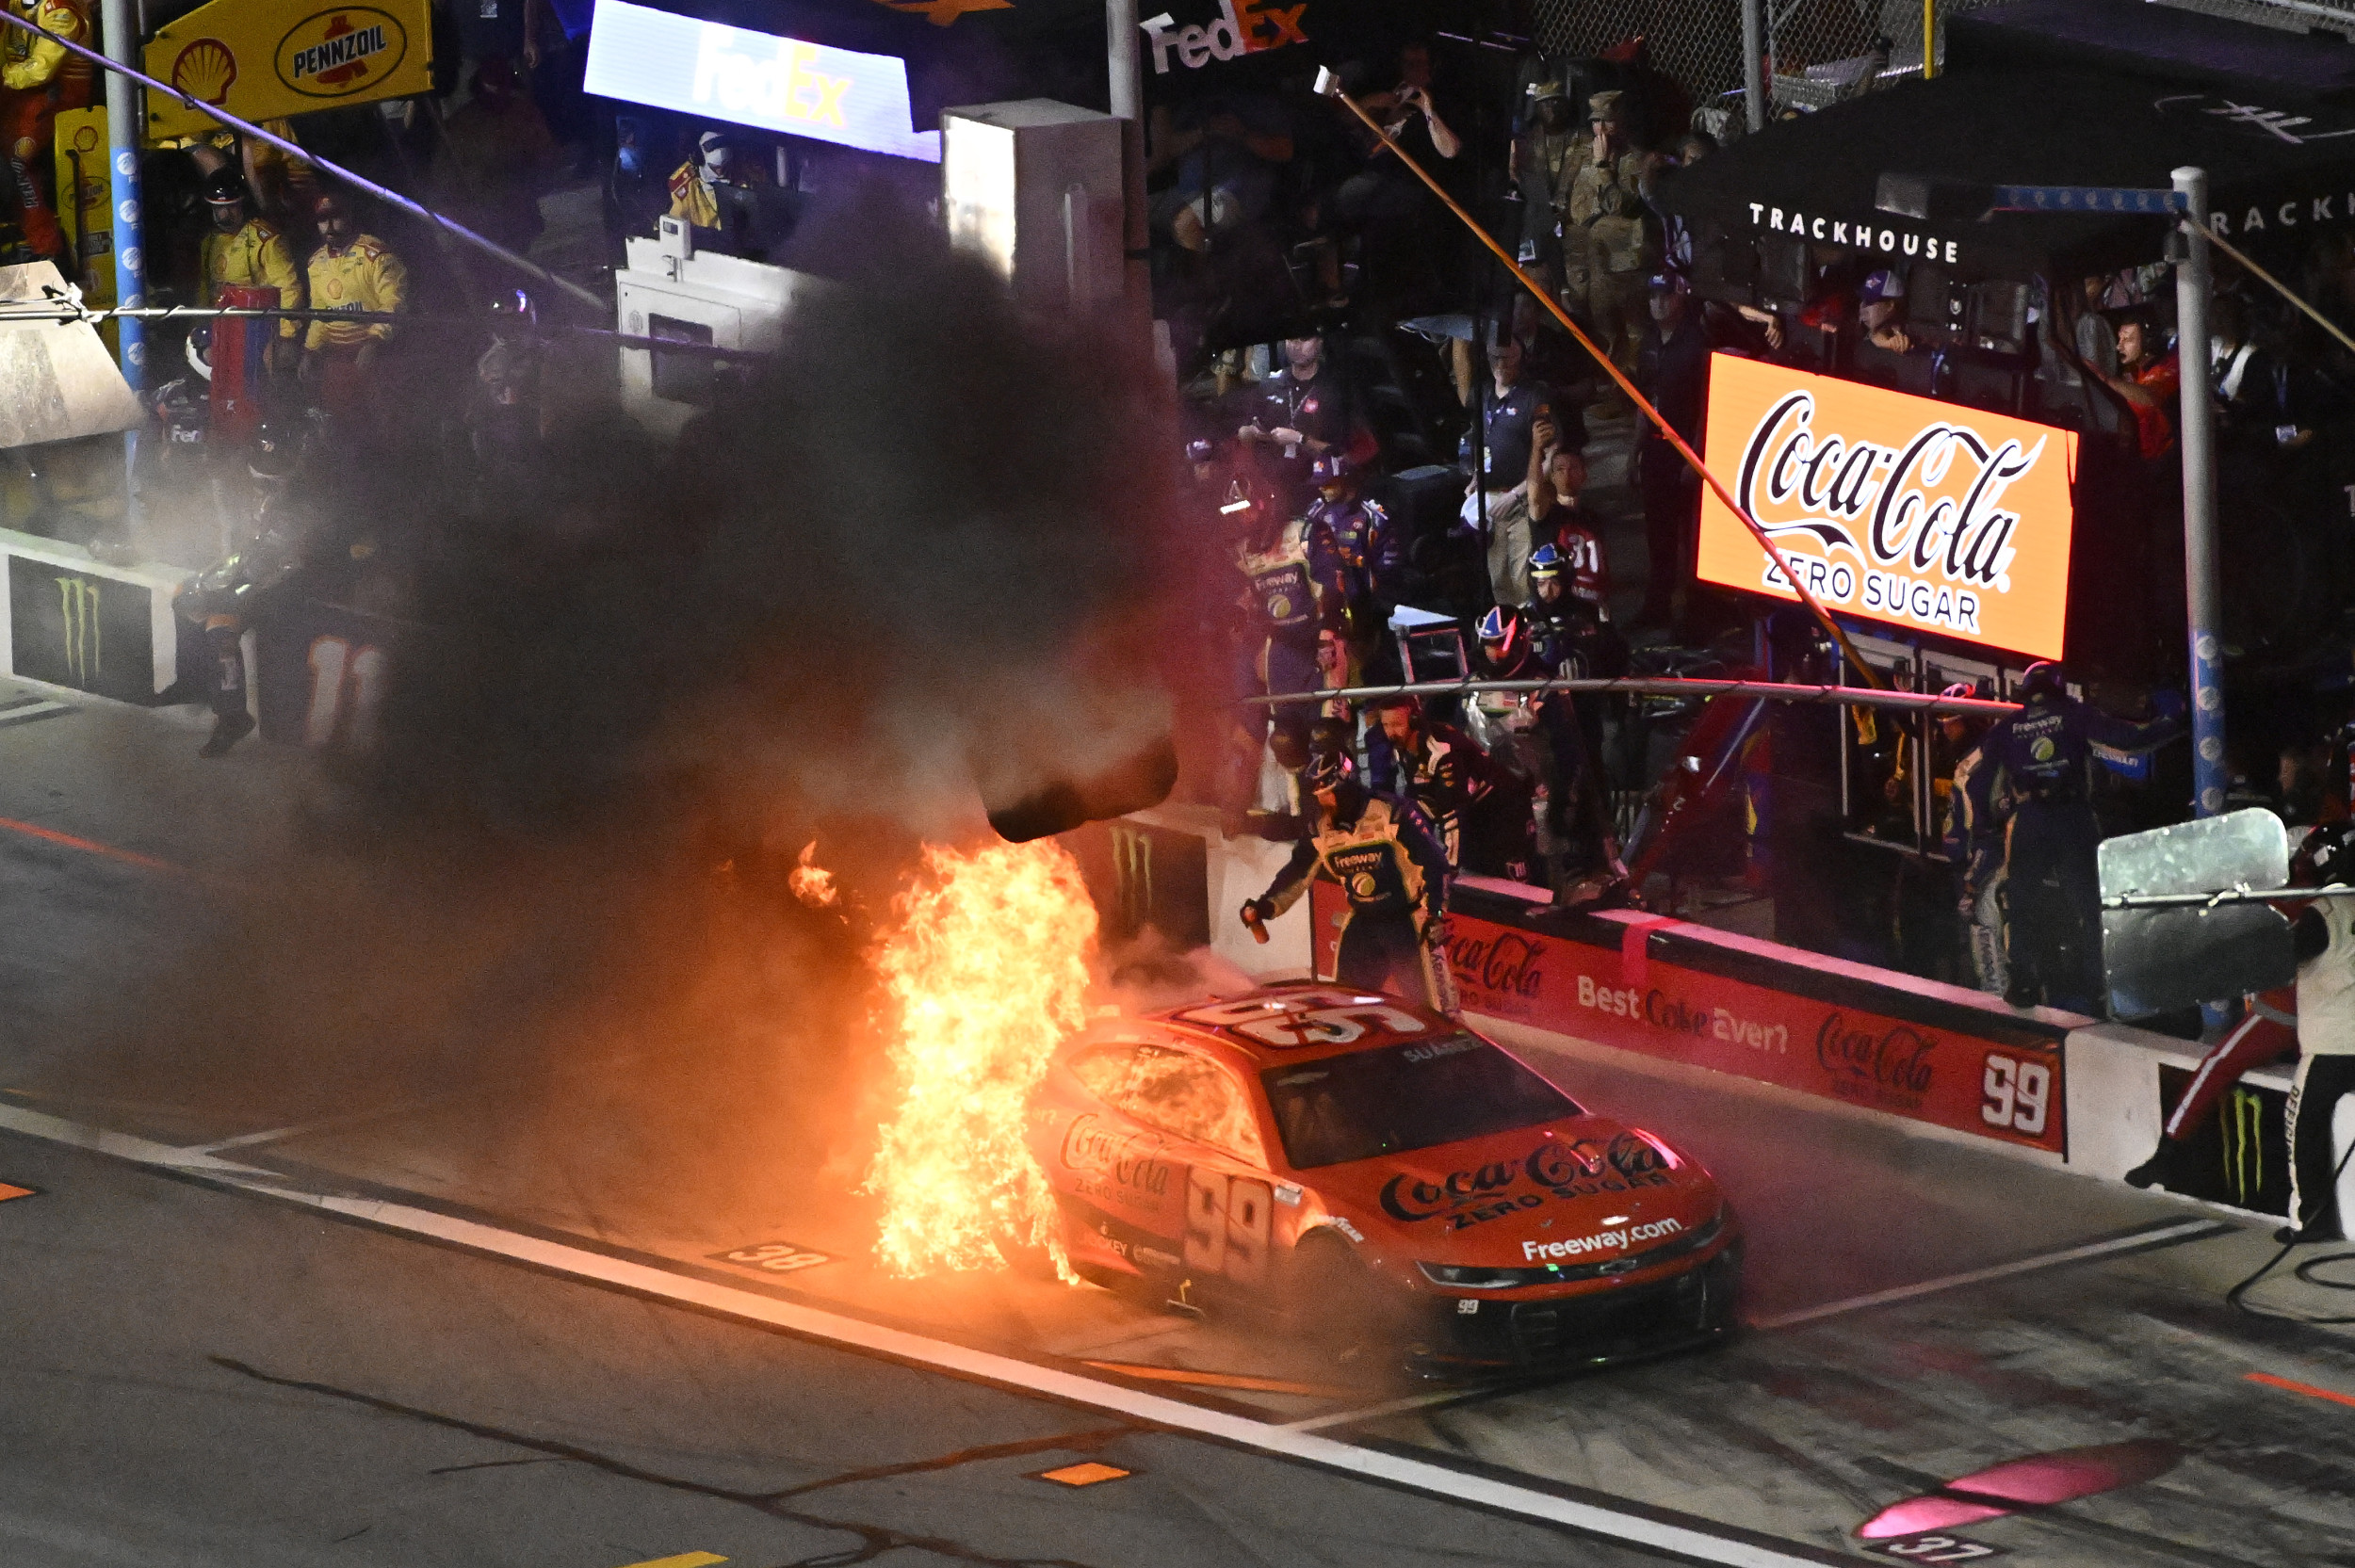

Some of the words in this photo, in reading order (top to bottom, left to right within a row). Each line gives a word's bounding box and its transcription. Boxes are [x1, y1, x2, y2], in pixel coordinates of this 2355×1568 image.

[292, 24, 388, 79] PENNZOIL
[1139, 0, 1308, 74] FedEx
[693, 23, 852, 129] FedEx
[1748, 202, 1958, 264] TRACKHOUSE
[1765, 556, 1853, 600] ZERO
[1865, 573, 1977, 629] SUGAR
[1334, 851, 1383, 870] Freeway
[1577, 974, 1640, 1021] Best
[1982, 1054, 2051, 1135] 99
[1183, 1164, 1274, 1277] 99
[1446, 1194, 1544, 1230] ZERO
[728, 1245, 829, 1270] 38
[1521, 1217, 1682, 1262] Freeway.com
[1457, 1299, 1479, 1315] 99
[1888, 1537, 1994, 1561] 37
